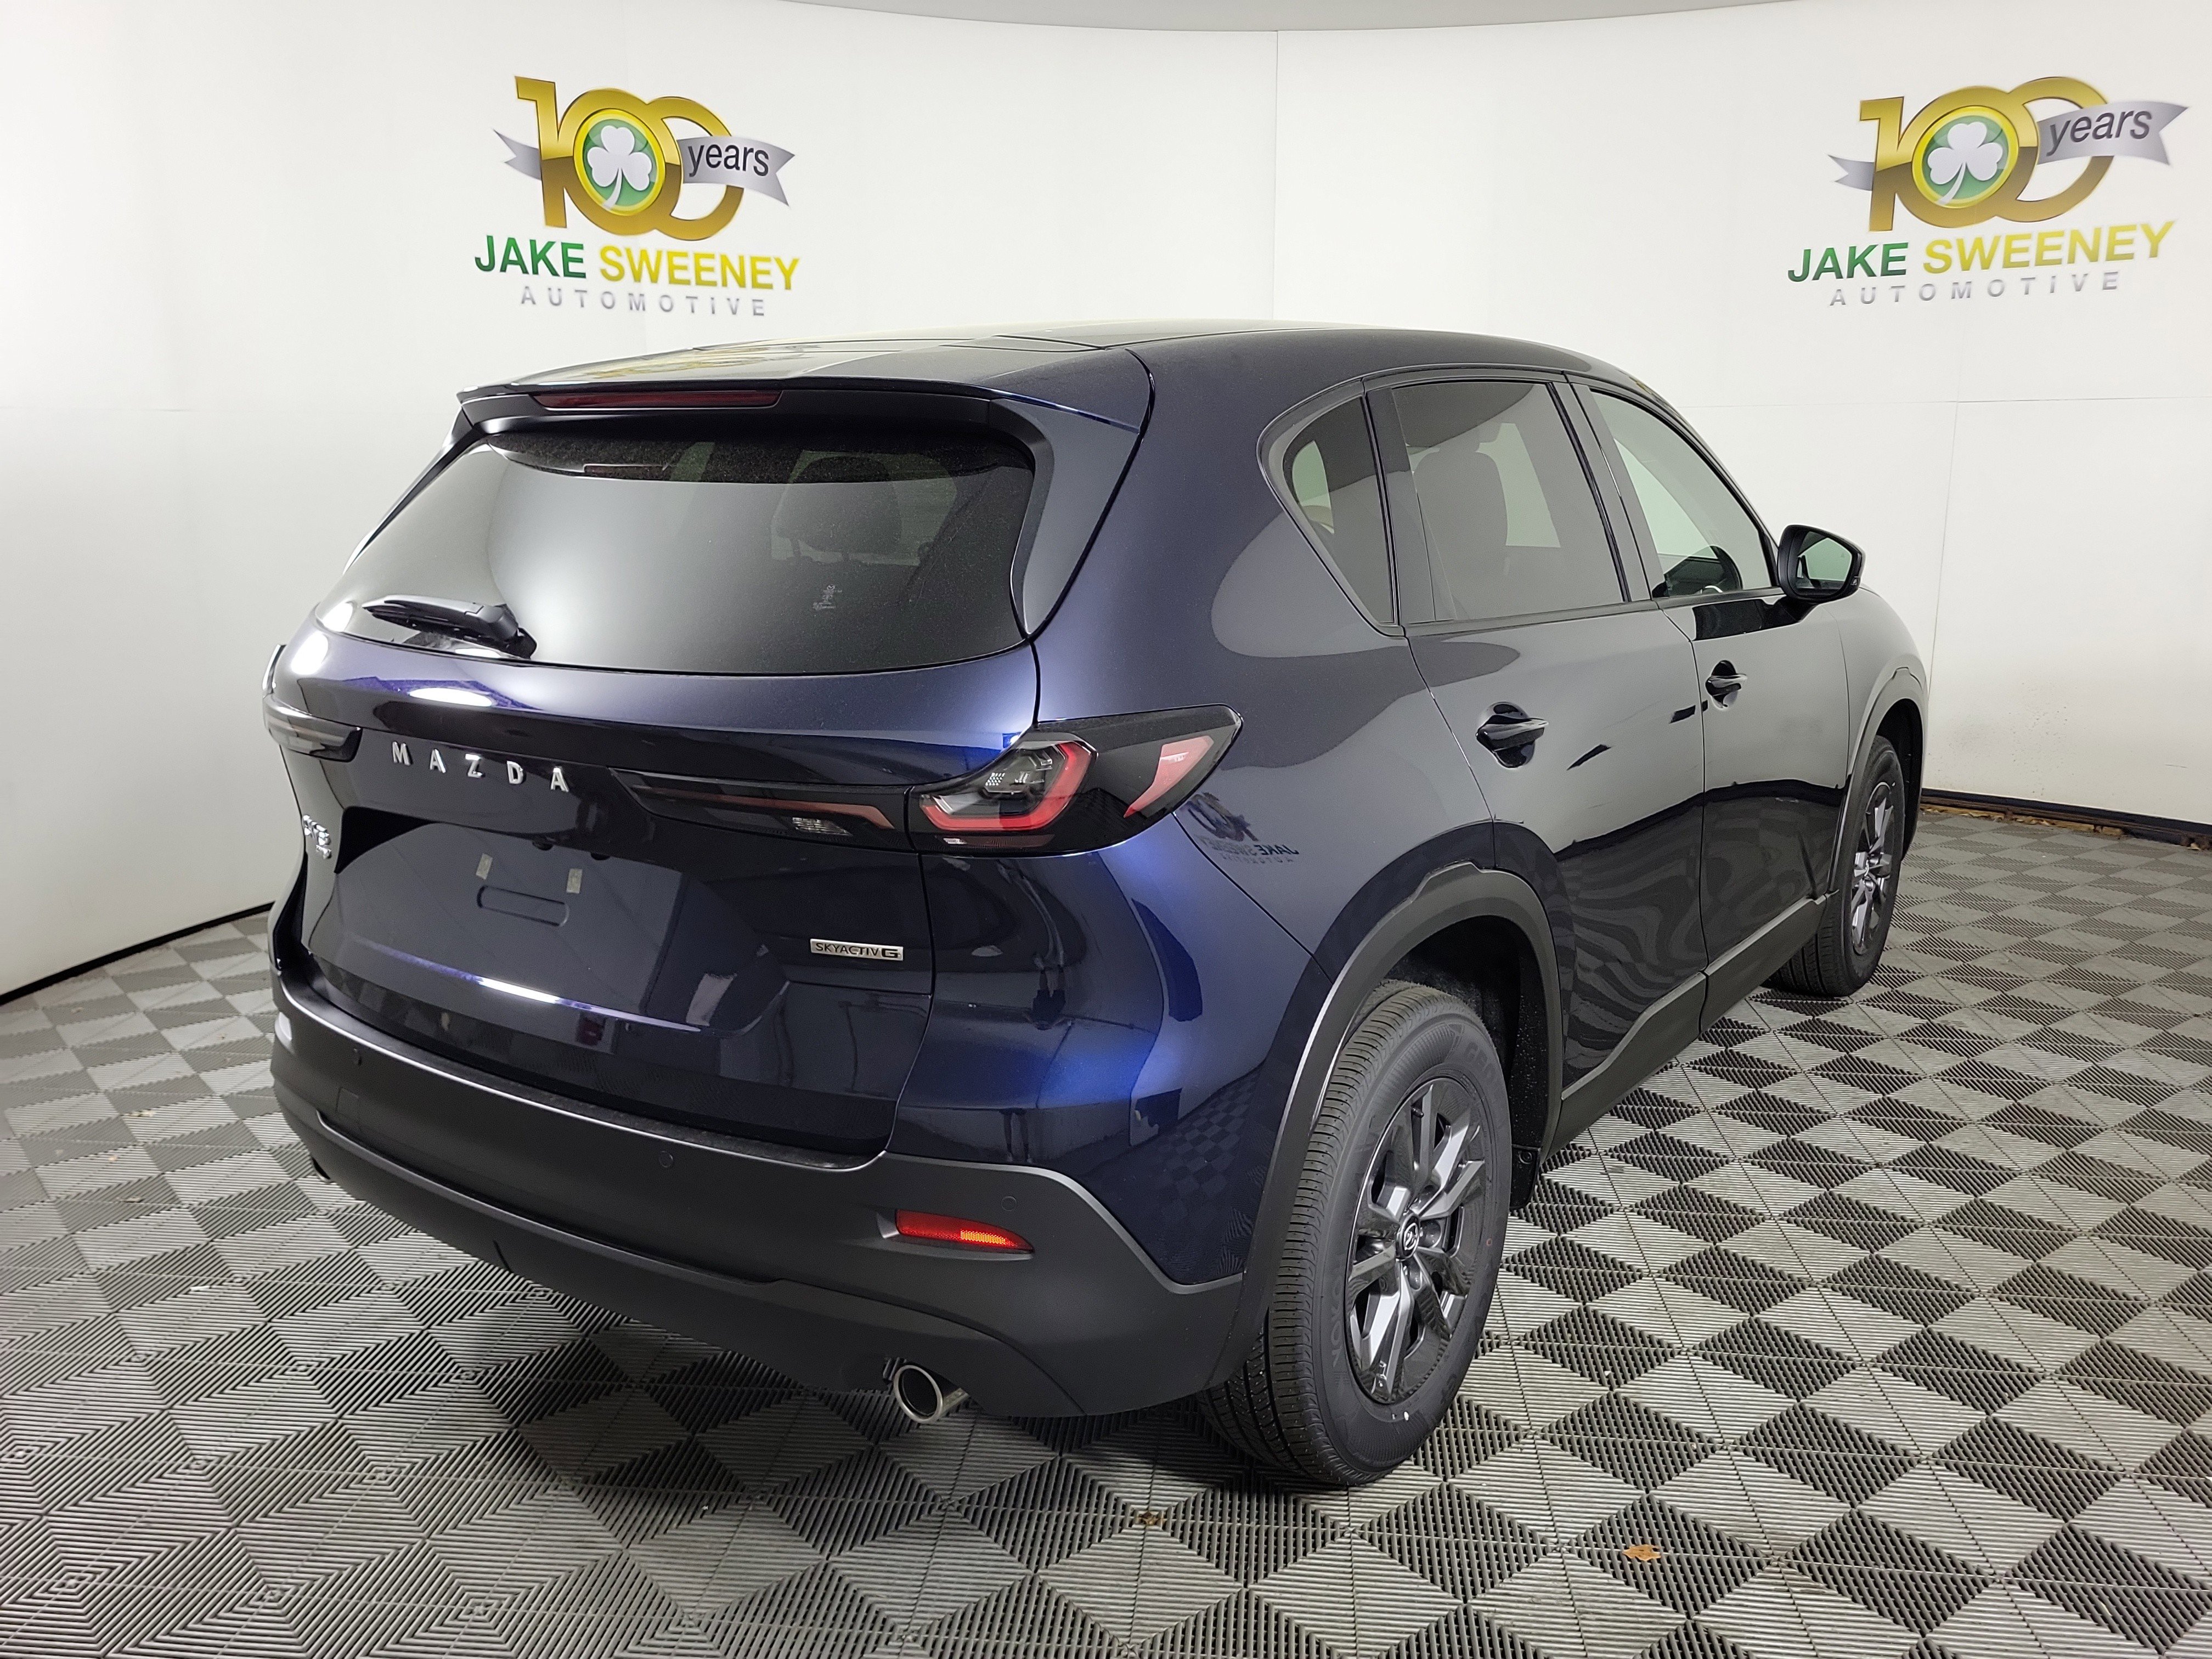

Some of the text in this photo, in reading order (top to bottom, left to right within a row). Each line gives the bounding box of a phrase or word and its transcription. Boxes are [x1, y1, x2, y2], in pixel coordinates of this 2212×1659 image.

[1859, 76, 2115, 232] 100
[2046, 110, 2152, 157] years
[515, 76, 744, 241] 100
[688, 143, 769, 177] years
[475, 235, 800, 290] JAKE SWEENEY
[1787, 221, 2175, 283] JAKE SWEENEY
[521, 285, 765, 317] AUTOMOTIVE
[1830, 272, 2120, 307] AUTOMOTIVE
[392, 741, 569, 793] MAZDA
[815, 942, 879, 956] SKYACTIV
